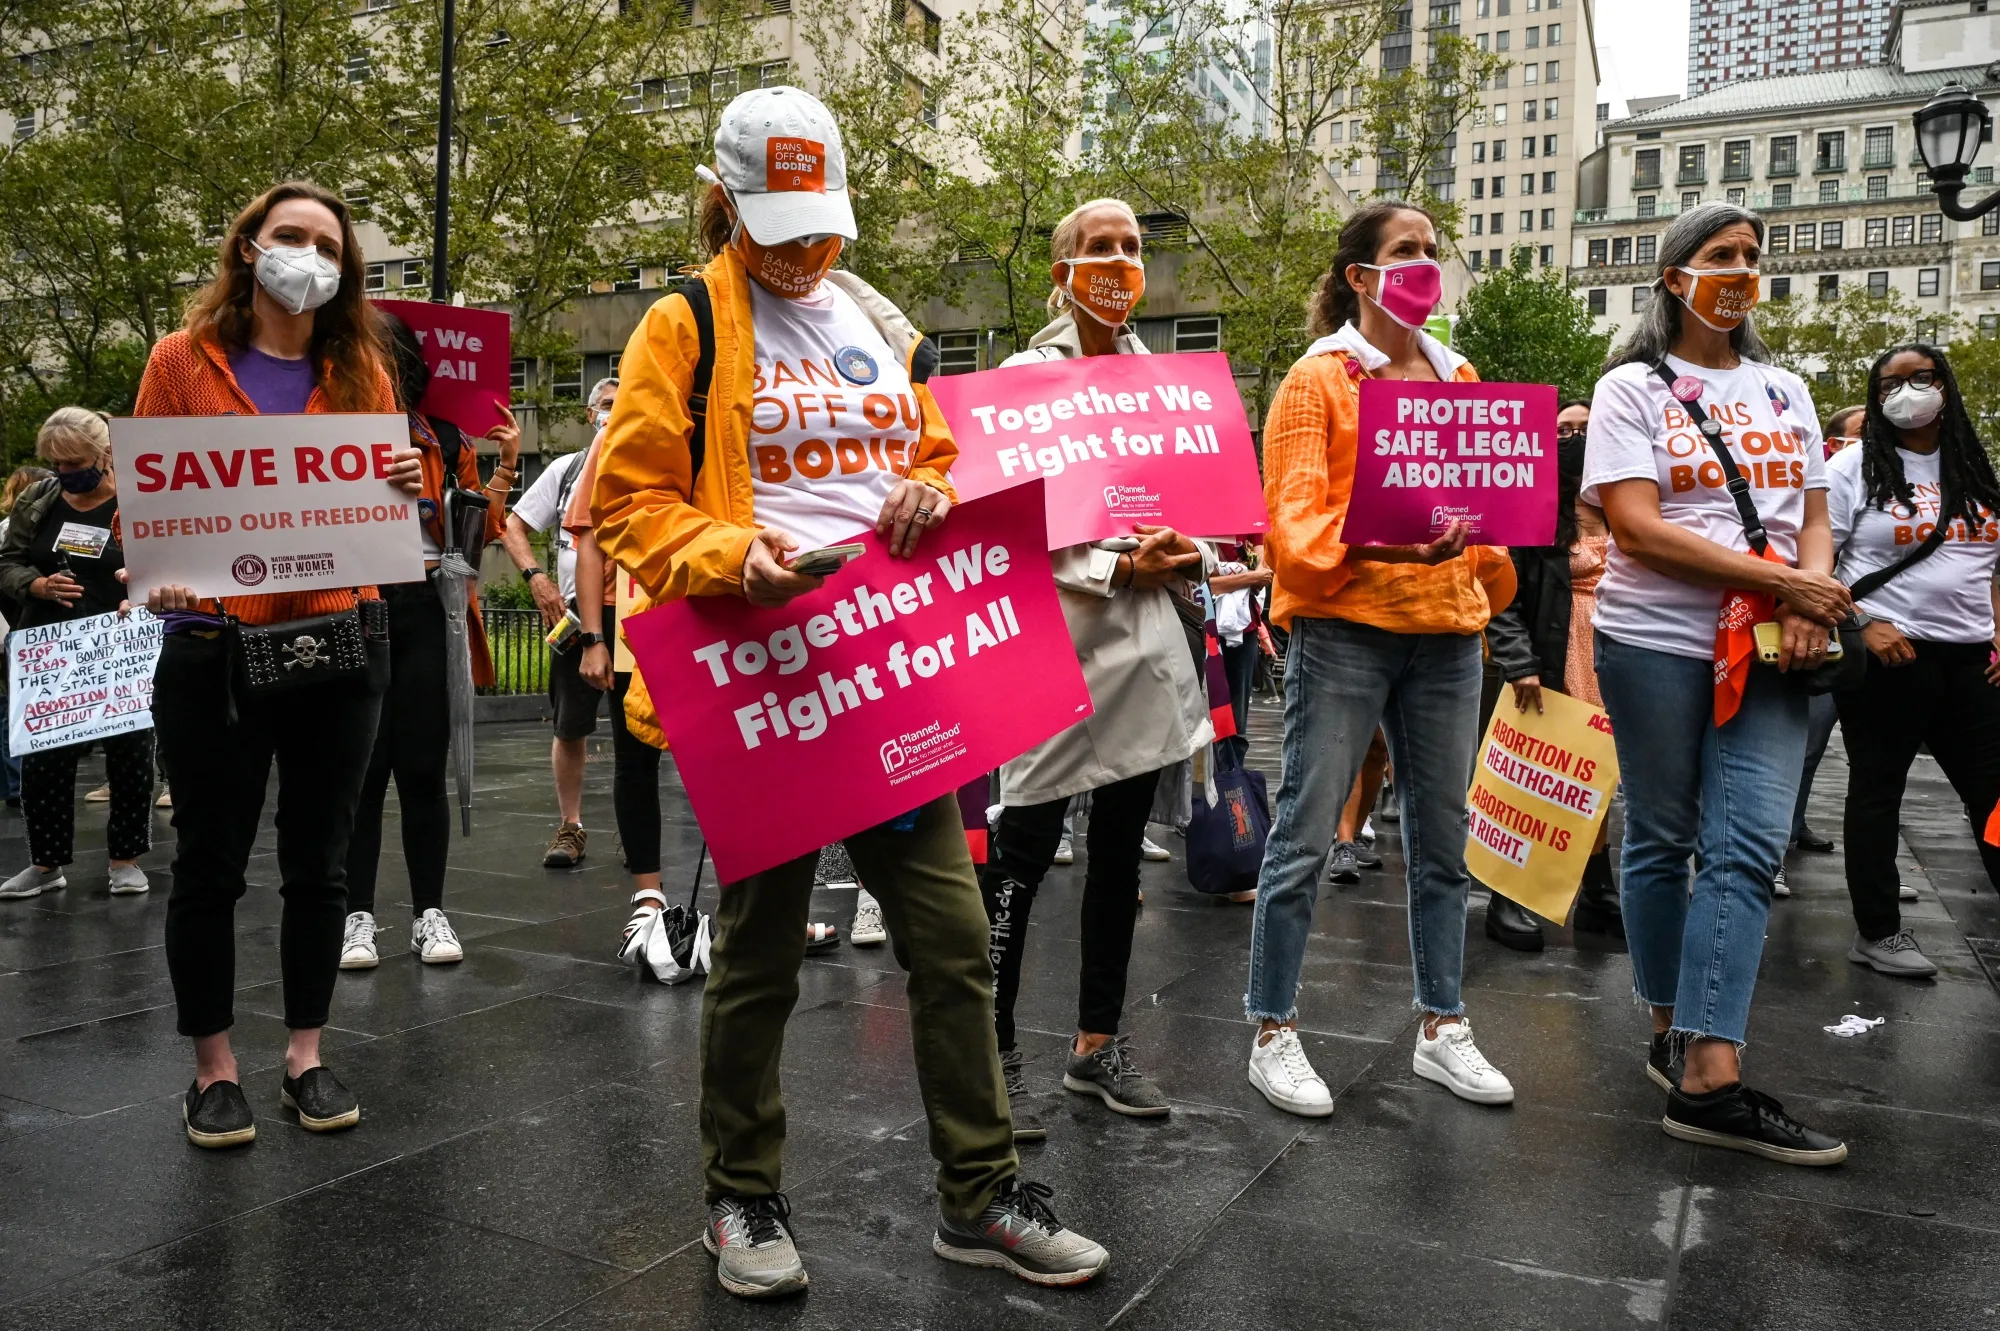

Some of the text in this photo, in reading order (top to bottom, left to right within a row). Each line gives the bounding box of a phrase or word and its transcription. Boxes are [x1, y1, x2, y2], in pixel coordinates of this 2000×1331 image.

[775, 142, 802, 152] BANS
[775, 151, 817, 165] OFF OUR
[775, 161, 813, 173] BODIES
[761, 262, 791, 280] OFF
[764, 251, 803, 276] BANS
[760, 270, 815, 293] BODIES
[1089, 284, 1134, 300] OFF OUR
[1090, 274, 1120, 289] BANS
[1719, 287, 1747, 300] BANS
[1089, 294, 1129, 311] BODIES
[1716, 297, 1740, 309] OFF
[434, 328, 484, 353] We
[434, 359, 477, 382] All
[753, 358, 865, 394] BAN
[751, 393, 922, 435] OFF OU
[971, 384, 1214, 435] Together We
[1397, 397, 1525, 426] PROTECT
[996, 424, 1221, 479] Fight for All
[1374, 429, 1543, 460] SAFE, LEGAL
[134, 443, 394, 493] SAVE ROE
[1382, 462, 1534, 488] ABORTION
[1118, 485, 1146, 494] Planned
[1120, 493, 1160, 502] Parenthood
[132, 503, 409, 539] DEFEND OUR FREEDOM
[1443, 505, 1469, 513] Planned
[270, 552, 333, 563] NATIONAL ORGANIZATION
[271, 559, 335, 575] FOR WOMEN
[692, 542, 1011, 688] Together We
[1728, 611, 1754, 632] BANS
[1730, 603, 1749, 620] OFF
[25, 622, 73, 645] BANS
[79, 618, 97, 631] off
[101, 611, 132, 628] OUR
[17, 621, 164, 662] STOP THE VIGILANT
[22, 636, 164, 673] TEXAS BOUNTY HUNTE
[19, 652, 157, 689] THEY ARE COMING
[38, 664, 150, 697] A STATE NEAR
[733, 595, 1021, 751] Fight for All
[1714, 668, 1728, 685] UR
[23, 687, 108, 719] ABORTION
[114, 682, 133, 697] ON
[24, 707, 97, 733] WITHOUT
[899, 719, 940, 746] Planned
[904, 722, 961, 758] Parenthood
[1492, 718, 1597, 782] ABORTION IS
[889, 746, 967, 787] Planned Parenthood Action Fund
[1486, 744, 1593, 815] HEALTHCARE.
[1471, 783, 1571, 852] ABORTION IS
[1468, 811, 1524, 863] A RIGHT.
[990, 911, 1012, 939] the
[988, 941, 1007, 965] of
